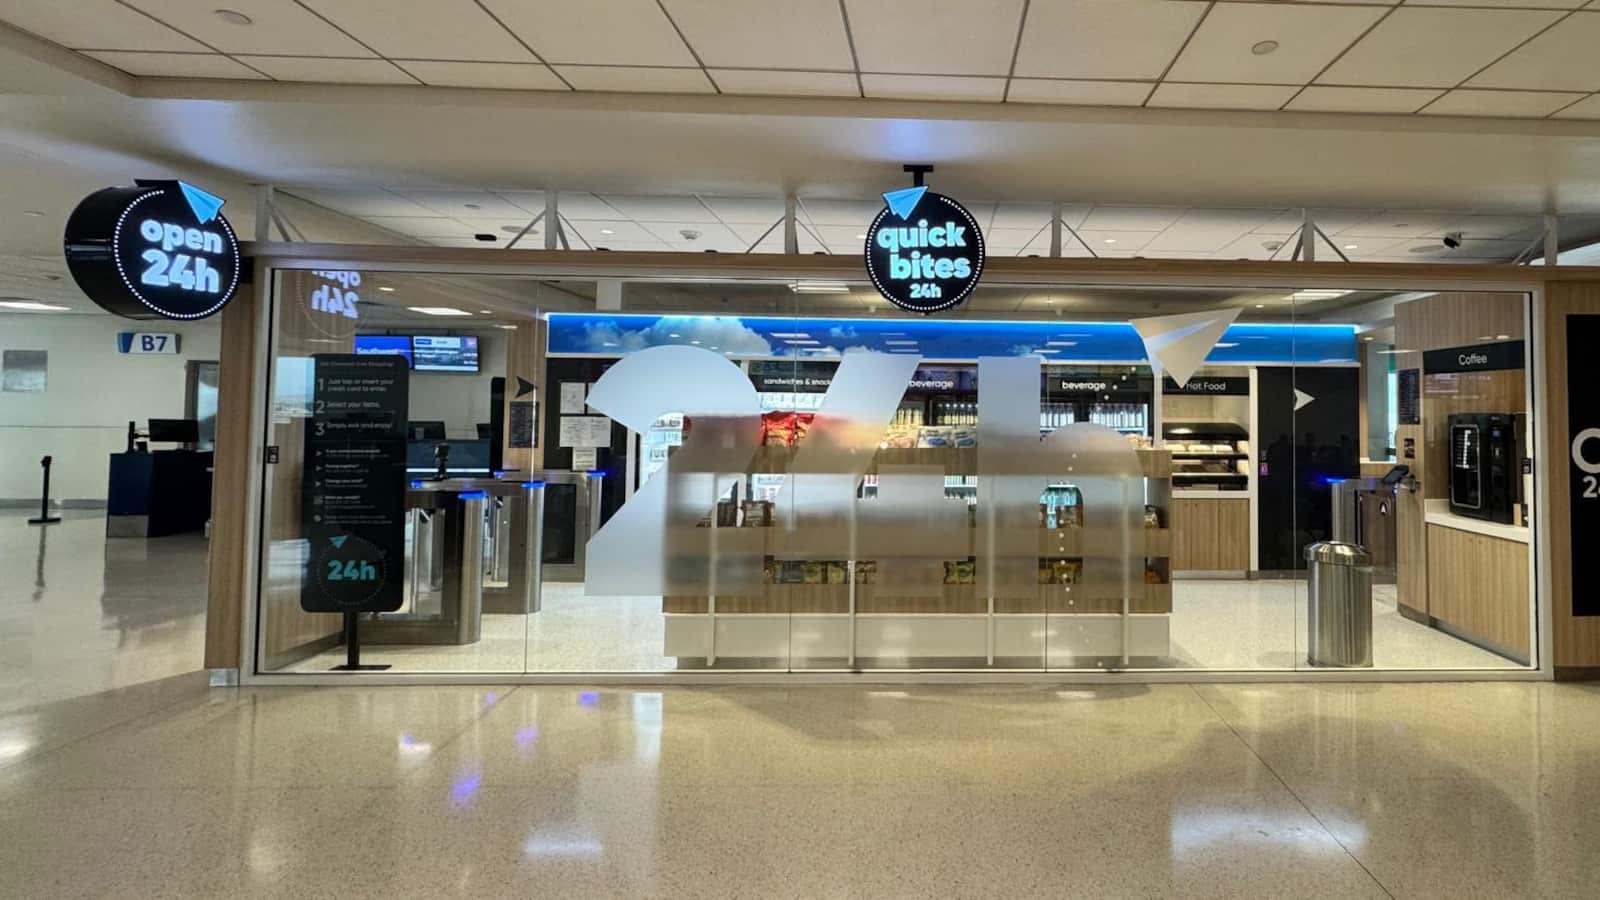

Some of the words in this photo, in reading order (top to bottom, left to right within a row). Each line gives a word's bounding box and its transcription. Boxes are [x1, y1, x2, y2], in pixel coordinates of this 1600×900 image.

[140, 219, 223, 254] open
[877, 219, 967, 253] quick
[141, 249, 220, 293] 24h
[890, 250, 971, 279] bites
[909, 283, 943, 299] 24h
[141, 335, 169, 352] B7
[1458, 353, 1488, 366] Coffee
[317, 378, 325, 392] 1
[763, 377, 804, 386] sandwiches
[804, 378, 811, 386] &
[811, 378, 833, 386] snack
[1061, 379, 1107, 391] beverage
[1203, 381, 1227, 391] Food
[315, 400, 326, 414] 2
[315, 422, 326, 437] 3
[584, 344, 1145, 597] 24h
[327, 559, 376, 581] 24h
